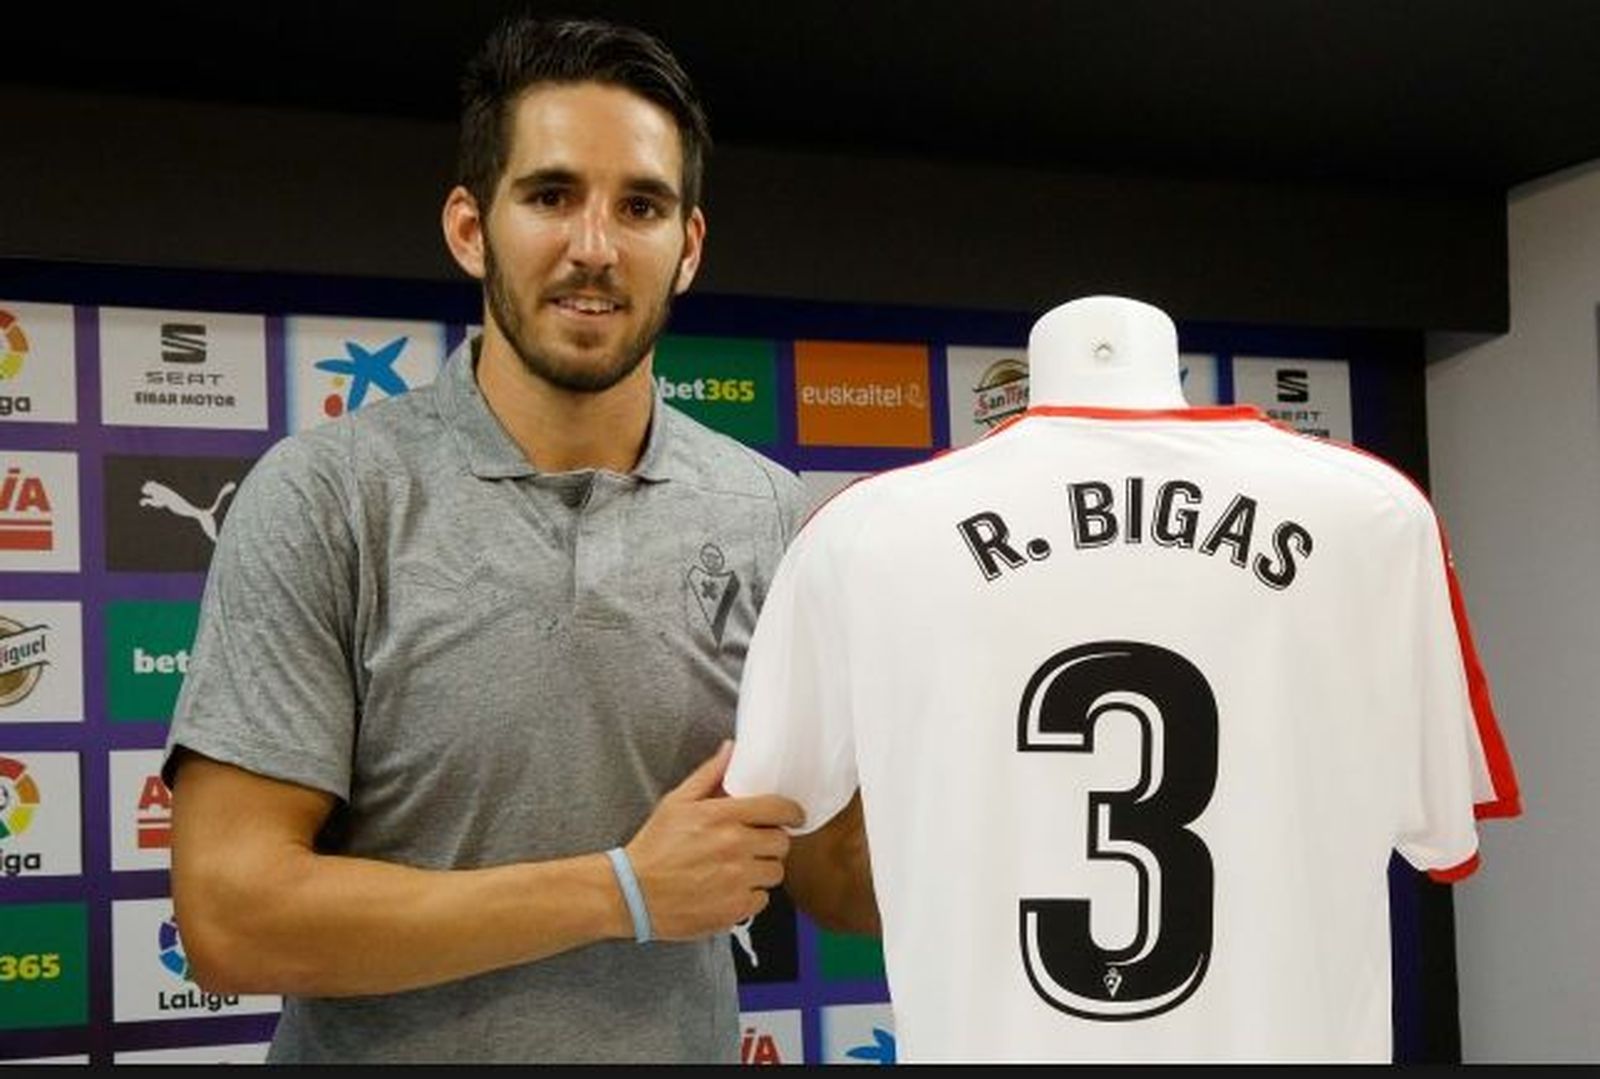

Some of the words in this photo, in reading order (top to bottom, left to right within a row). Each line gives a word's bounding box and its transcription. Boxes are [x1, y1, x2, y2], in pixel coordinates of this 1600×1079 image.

[145, 371, 224, 385] SEAT
[659, 376, 755, 401] bet365
[135, 391, 178, 406] EIBAR
[180, 394, 235, 408] MOTOR
[956, 511, 1052, 581] R.
[1067, 477, 1314, 590] BIGAS
[0, 634, 46, 668] iguel
[1017, 640, 1219, 1022] 3
[0, 954, 60, 980] 365
[159, 990, 239, 1012] LaLiga
